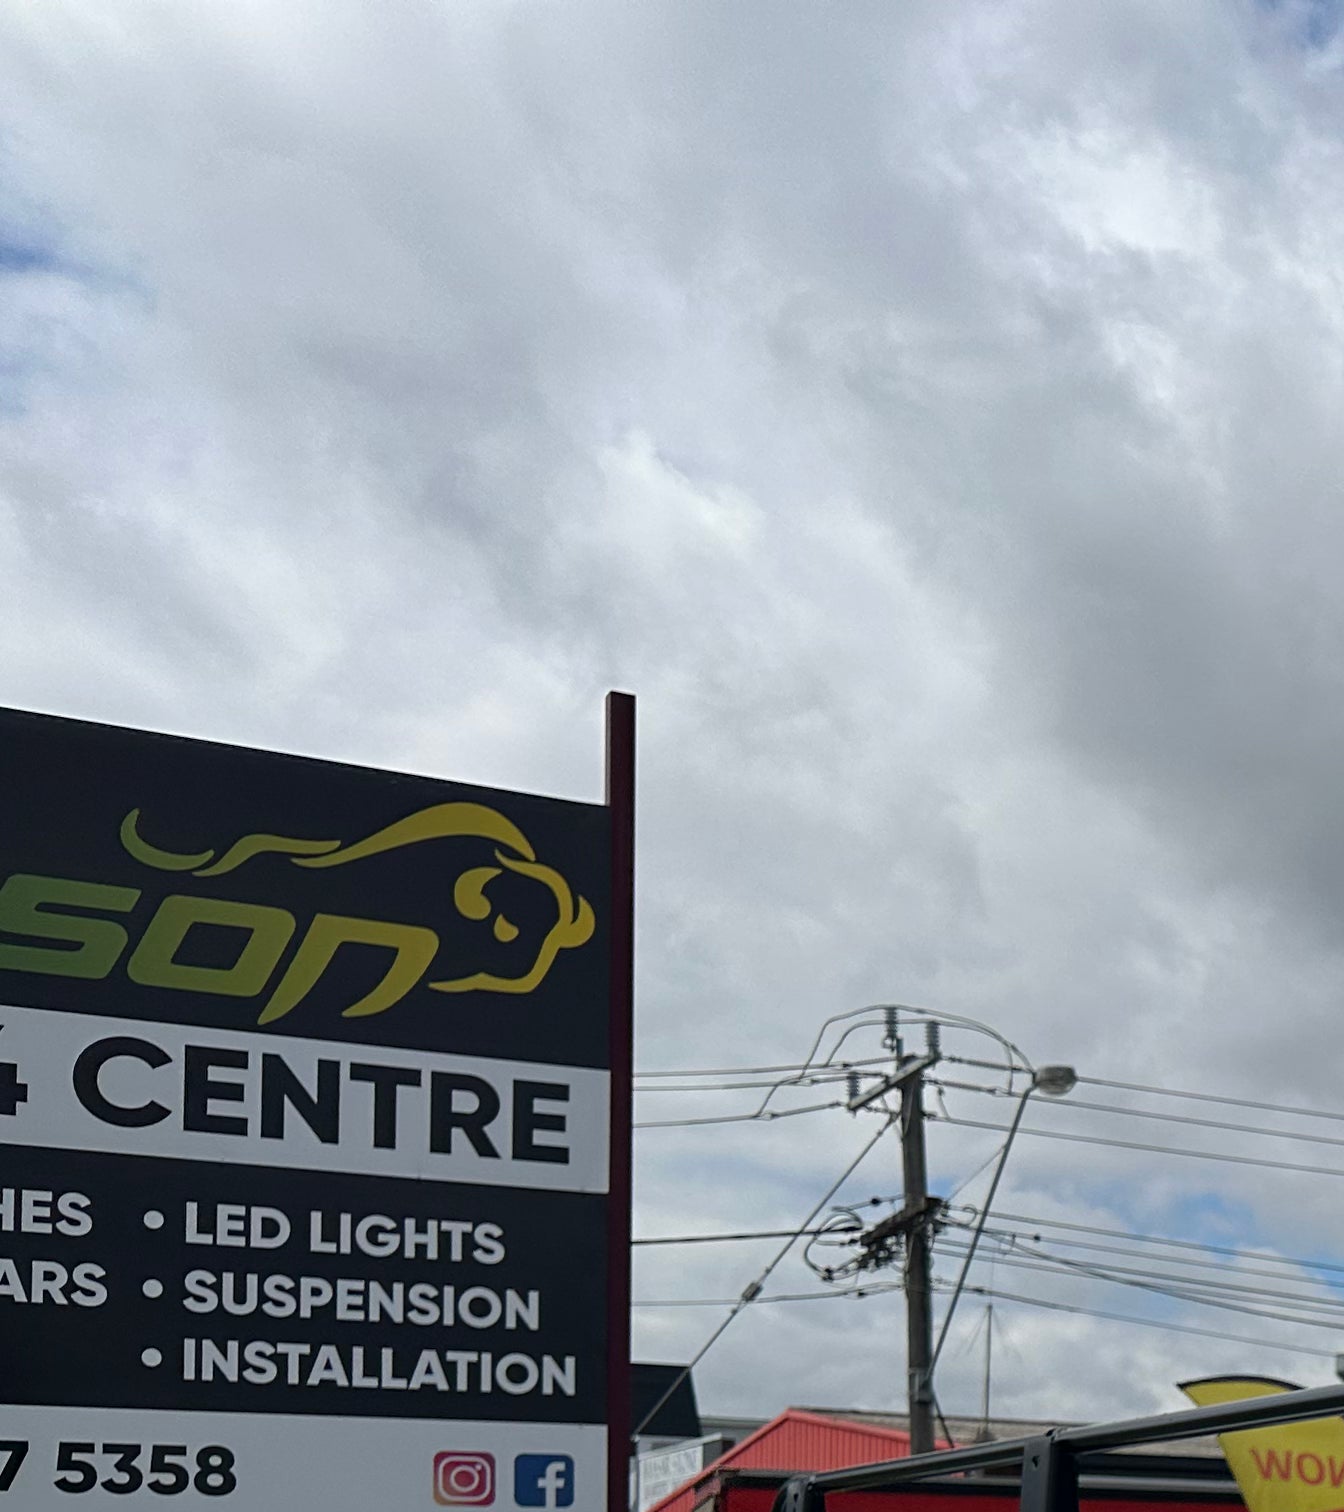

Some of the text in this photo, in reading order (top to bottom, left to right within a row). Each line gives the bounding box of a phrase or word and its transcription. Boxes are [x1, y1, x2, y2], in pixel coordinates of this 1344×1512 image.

[72, 1035, 571, 1165] CENTRE
[185, 1200, 506, 1265] LED LIGHTS
[183, 1268, 540, 1331] SUSPENSION
[183, 1337, 577, 1397] INSTALLATION
[53, 1441, 237, 1497] 5358
